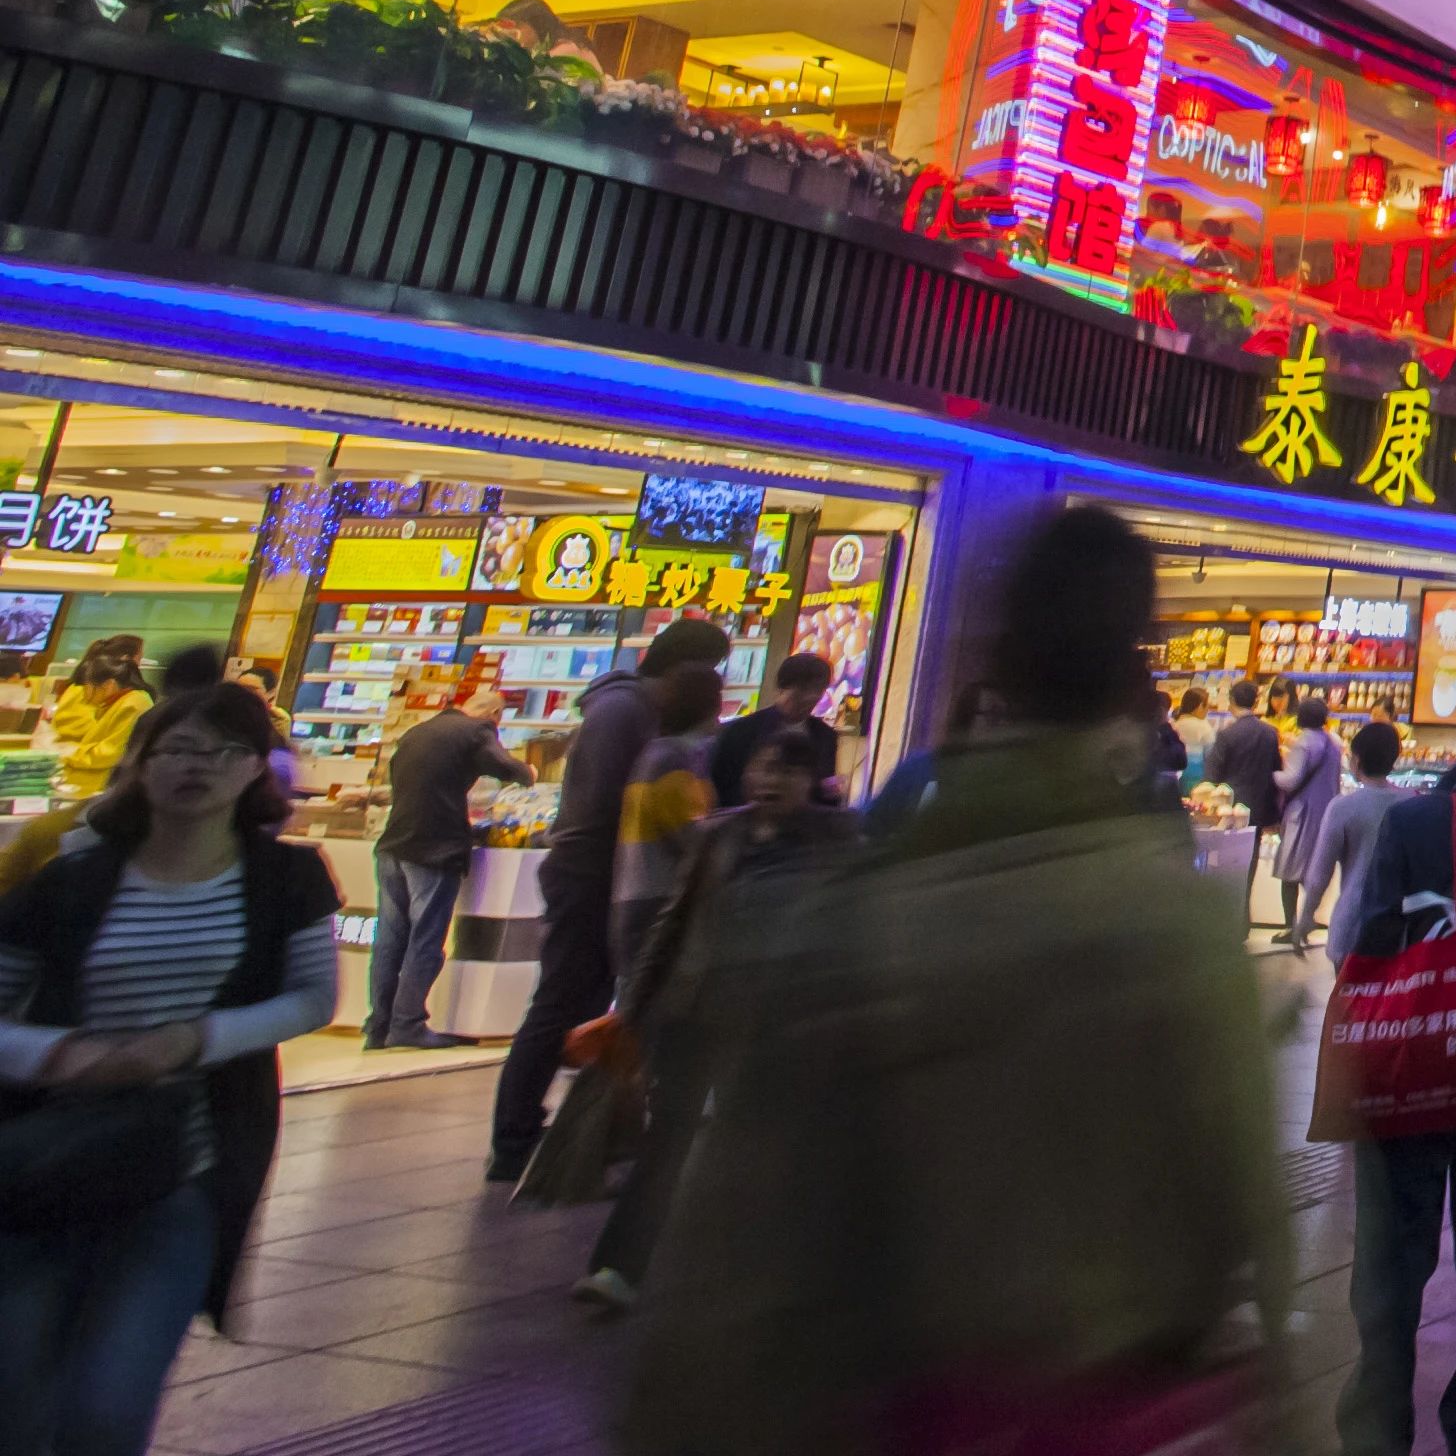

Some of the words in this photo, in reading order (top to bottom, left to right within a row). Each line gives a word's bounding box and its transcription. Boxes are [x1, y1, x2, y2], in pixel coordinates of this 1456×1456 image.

[0, 493, 111, 552] 月饼
[606, 557, 792, 617] 糖炒栗子
